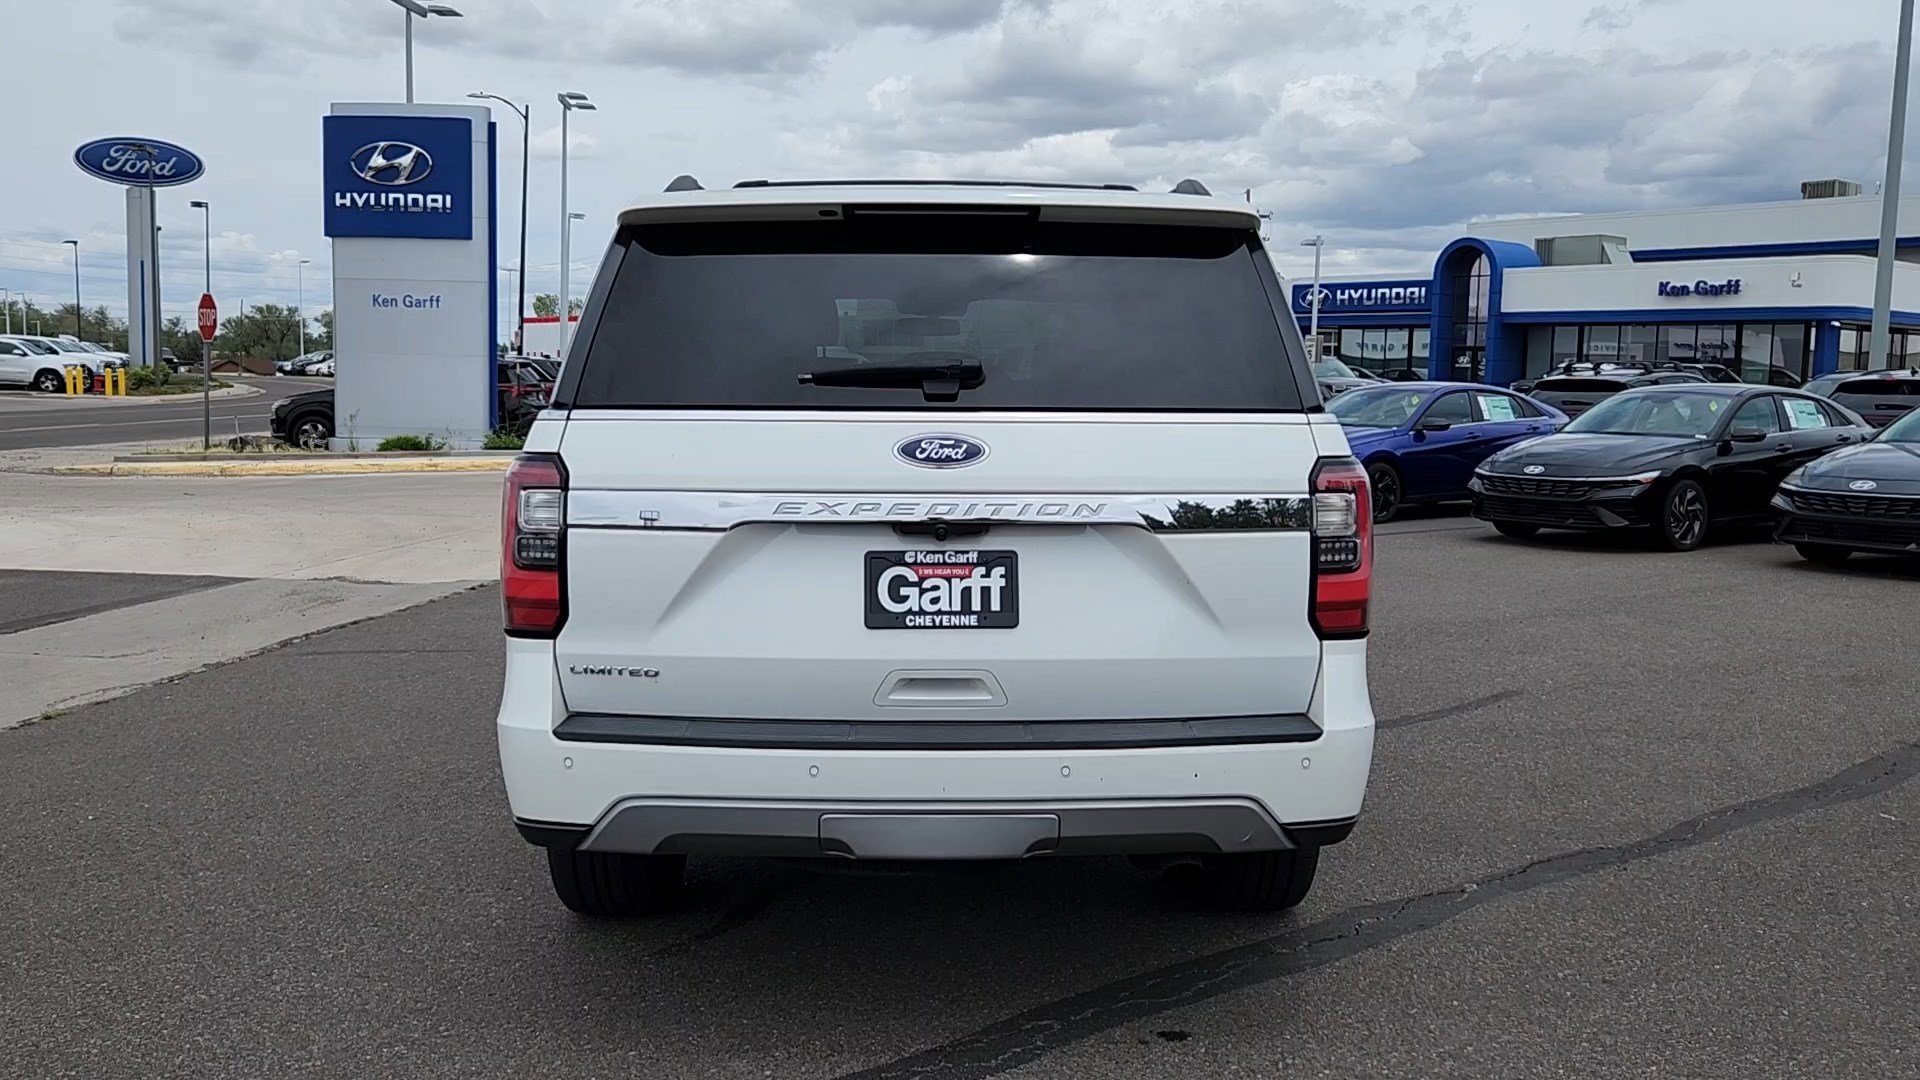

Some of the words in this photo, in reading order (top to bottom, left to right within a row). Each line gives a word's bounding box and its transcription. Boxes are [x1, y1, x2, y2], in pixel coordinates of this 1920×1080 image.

[102, 144, 178, 176] Ford
[334, 191, 452, 214] HYUNDAI
[1336, 286, 1426, 306] HYUNDAI
[1657, 281, 1690, 297] Ken
[1694, 279, 1742, 296] Garff
[372, 294, 398, 308] Ken
[402, 294, 441, 309] Garff
[199, 308, 216, 327] STOP
[915, 439, 968, 459] Ford
[772, 501, 1107, 518] EXPEDITION
[916, 551, 943, 564] Ken
[944, 551, 979, 564] Garff
[877, 566, 1006, 613] Garff
[905, 614, 979, 627] CHEYENNE
[569, 663, 660, 677] LIMITED
